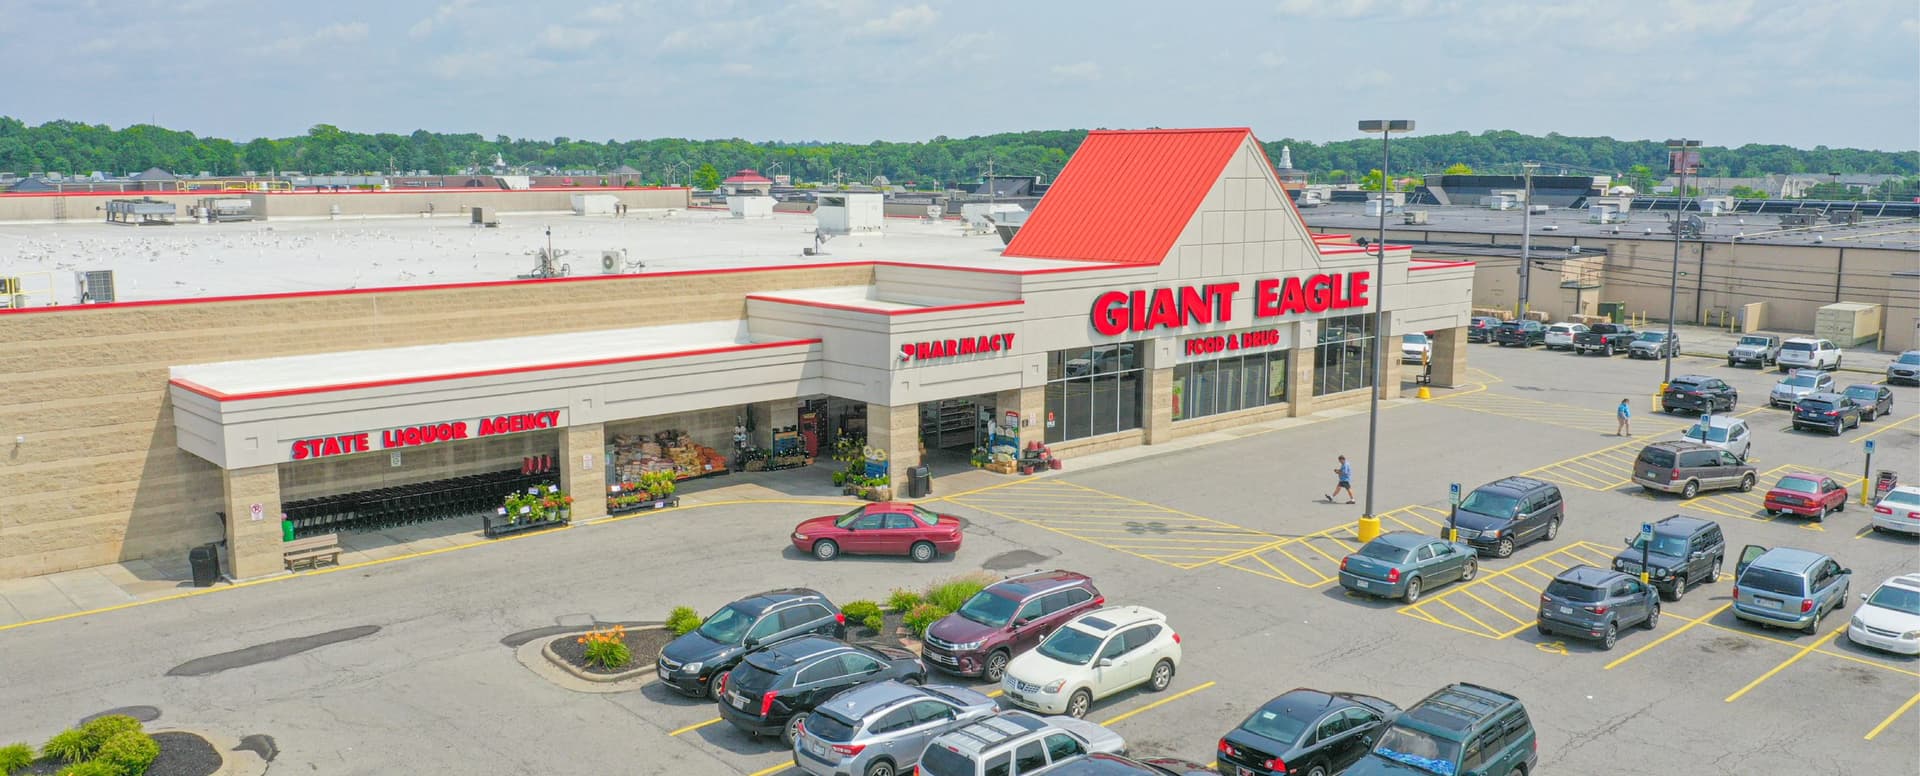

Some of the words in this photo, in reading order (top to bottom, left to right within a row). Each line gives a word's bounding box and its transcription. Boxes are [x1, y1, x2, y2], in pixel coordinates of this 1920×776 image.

[1091, 282, 1240, 336] GIANT
[1256, 271, 1369, 318] EAGLE
[902, 333, 1015, 361] PHARMACY
[1185, 336, 1225, 356] FOOD
[1227, 333, 1240, 350] &
[1242, 329, 1280, 349] DRUG
[291, 432, 369, 460] STATE
[383, 421, 468, 448] LIQUOR
[479, 410, 560, 436] AGENCY
